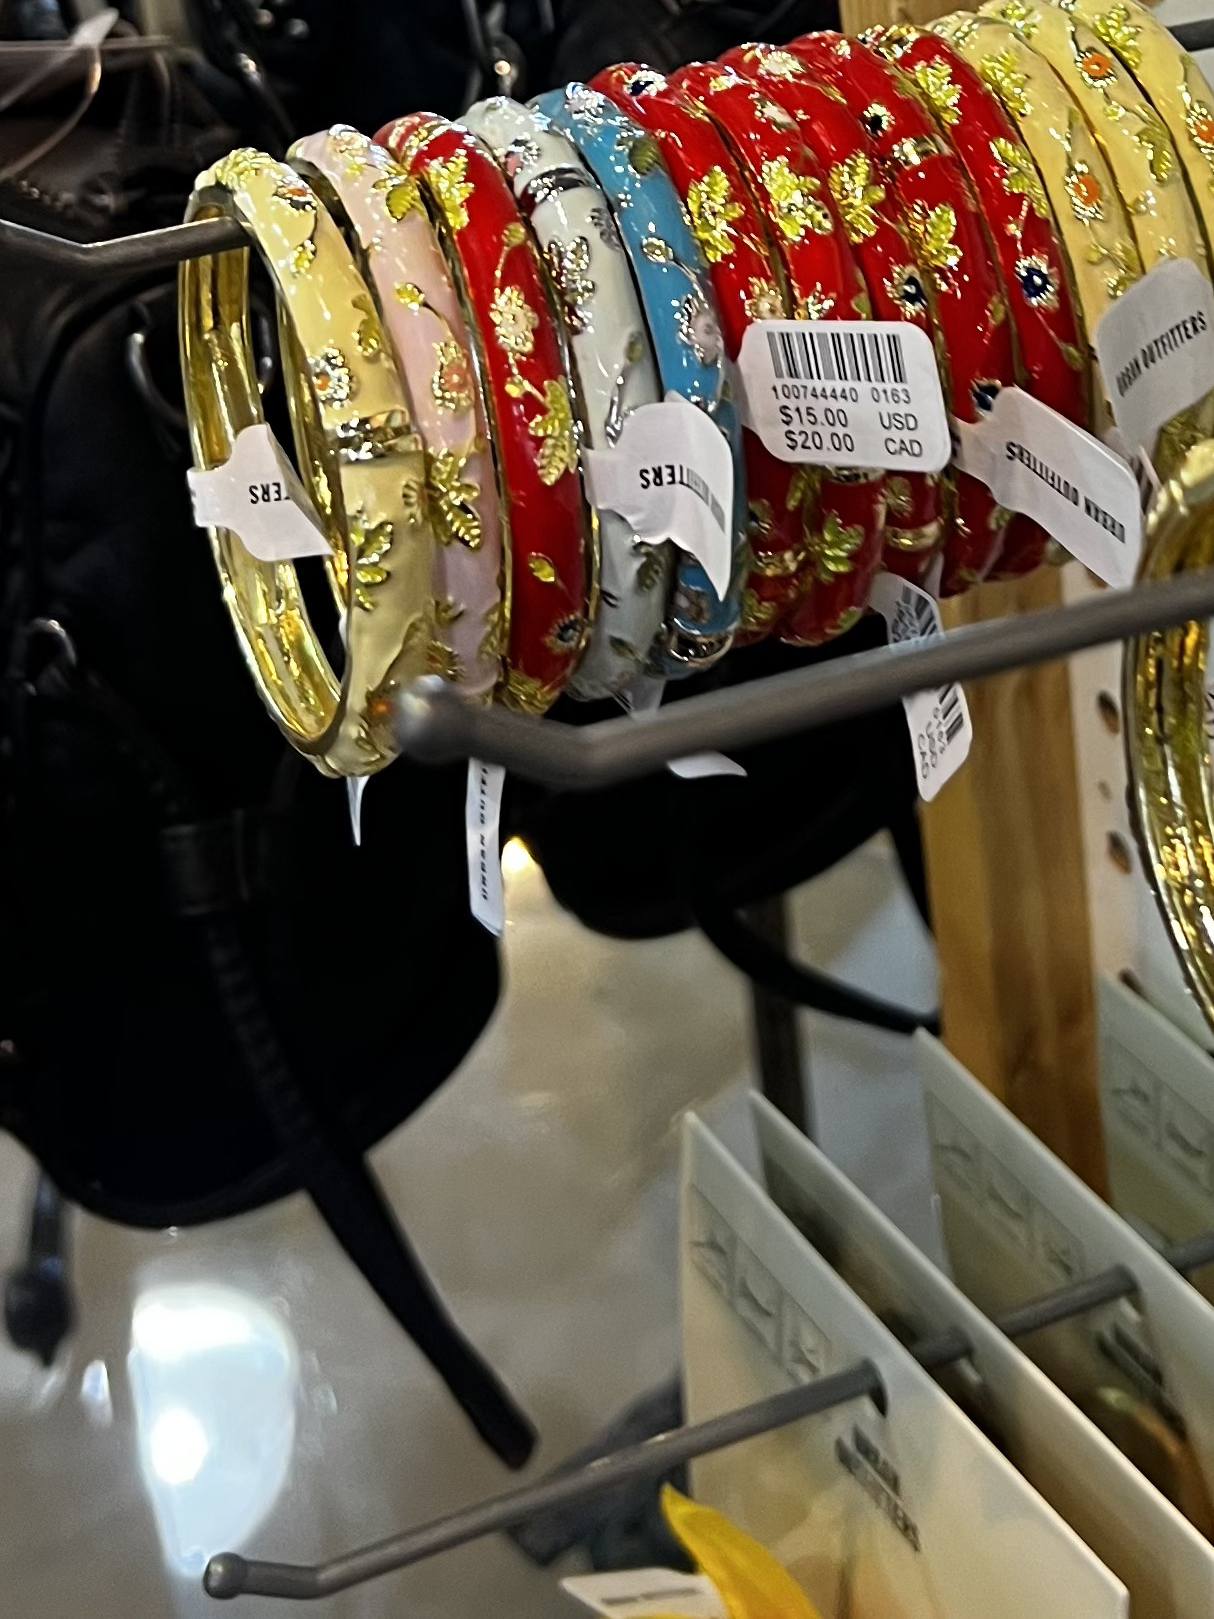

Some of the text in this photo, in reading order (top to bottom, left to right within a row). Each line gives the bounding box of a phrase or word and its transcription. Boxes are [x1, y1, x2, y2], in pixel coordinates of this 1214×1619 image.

[1141, 310, 1207, 370] OUTFITTERS
[771, 384, 911, 404] 100744440 0163
[779, 404, 918, 431] $15.00 USD
[784, 429, 923, 457] $20.00 CAD
